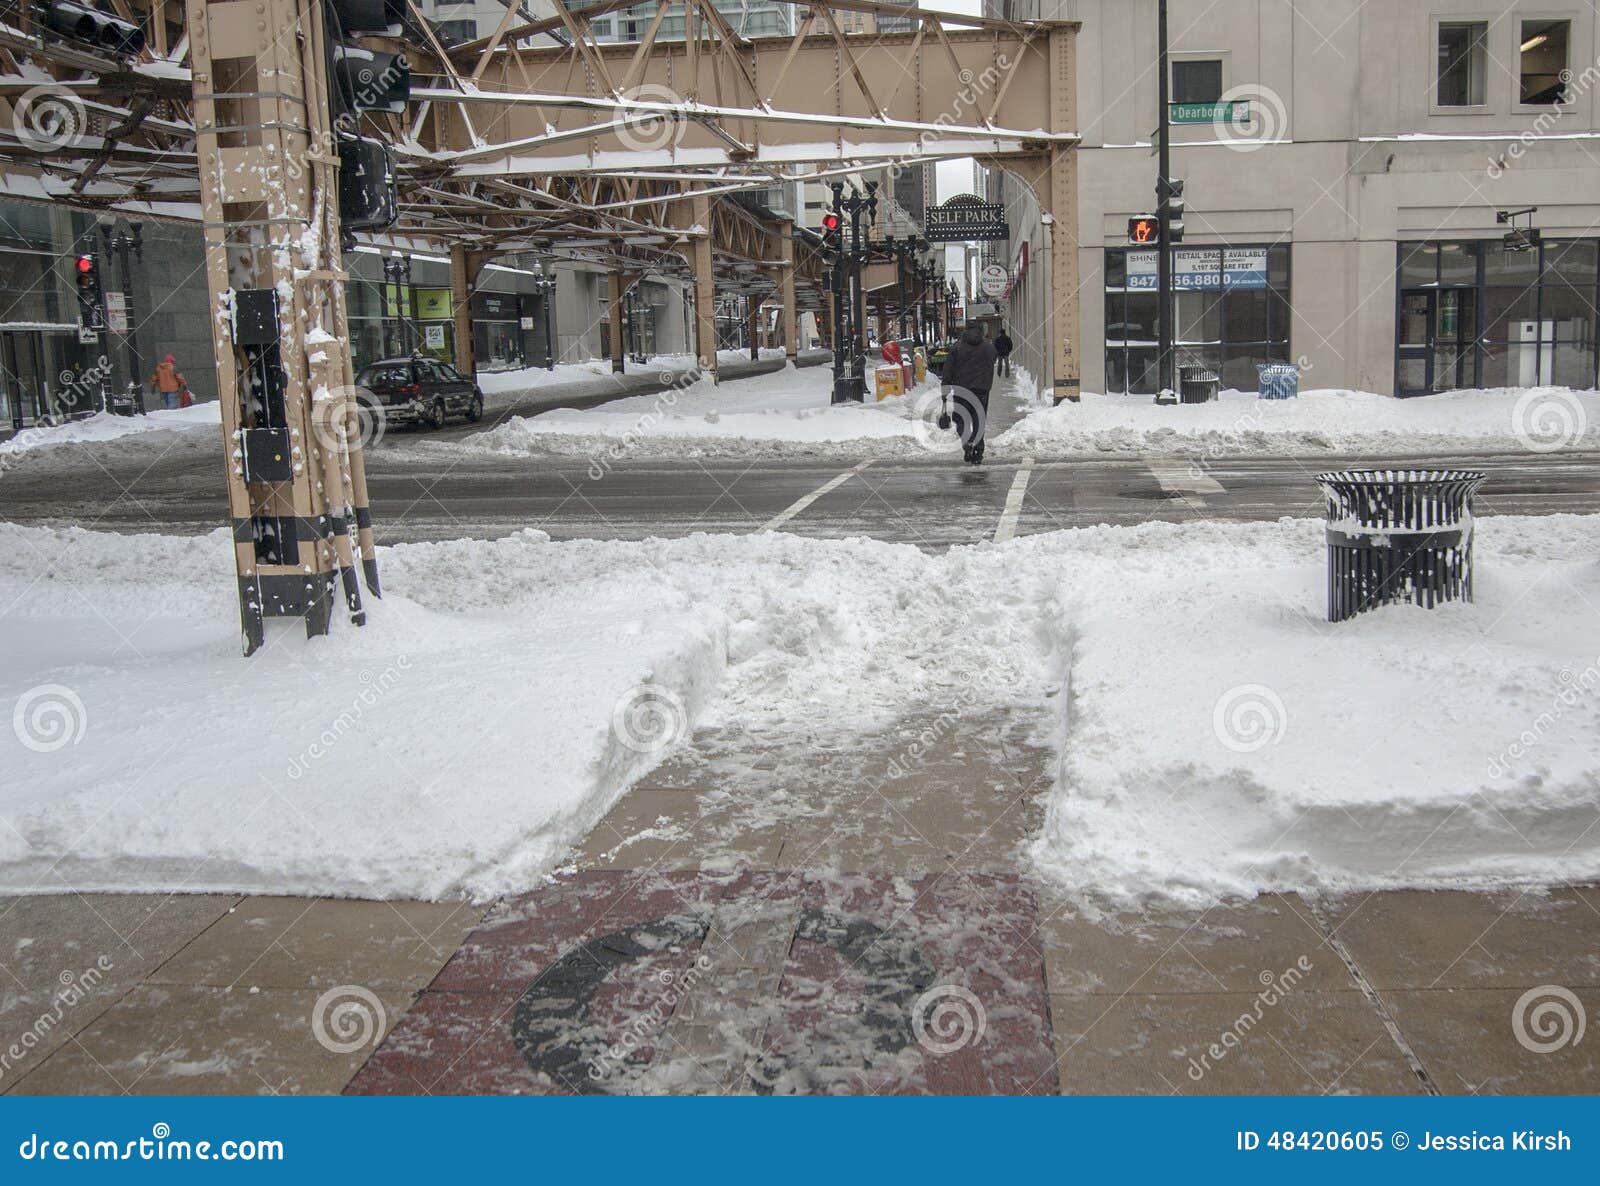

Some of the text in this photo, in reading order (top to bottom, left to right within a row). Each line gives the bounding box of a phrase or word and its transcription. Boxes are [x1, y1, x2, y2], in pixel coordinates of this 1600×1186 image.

[1178, 107, 1224, 119] Dearborn
[930, 209, 999, 224] SELF PARK
[1177, 252, 1201, 260] RETAIL
[1228, 250, 1266, 258] AVAILABLE
